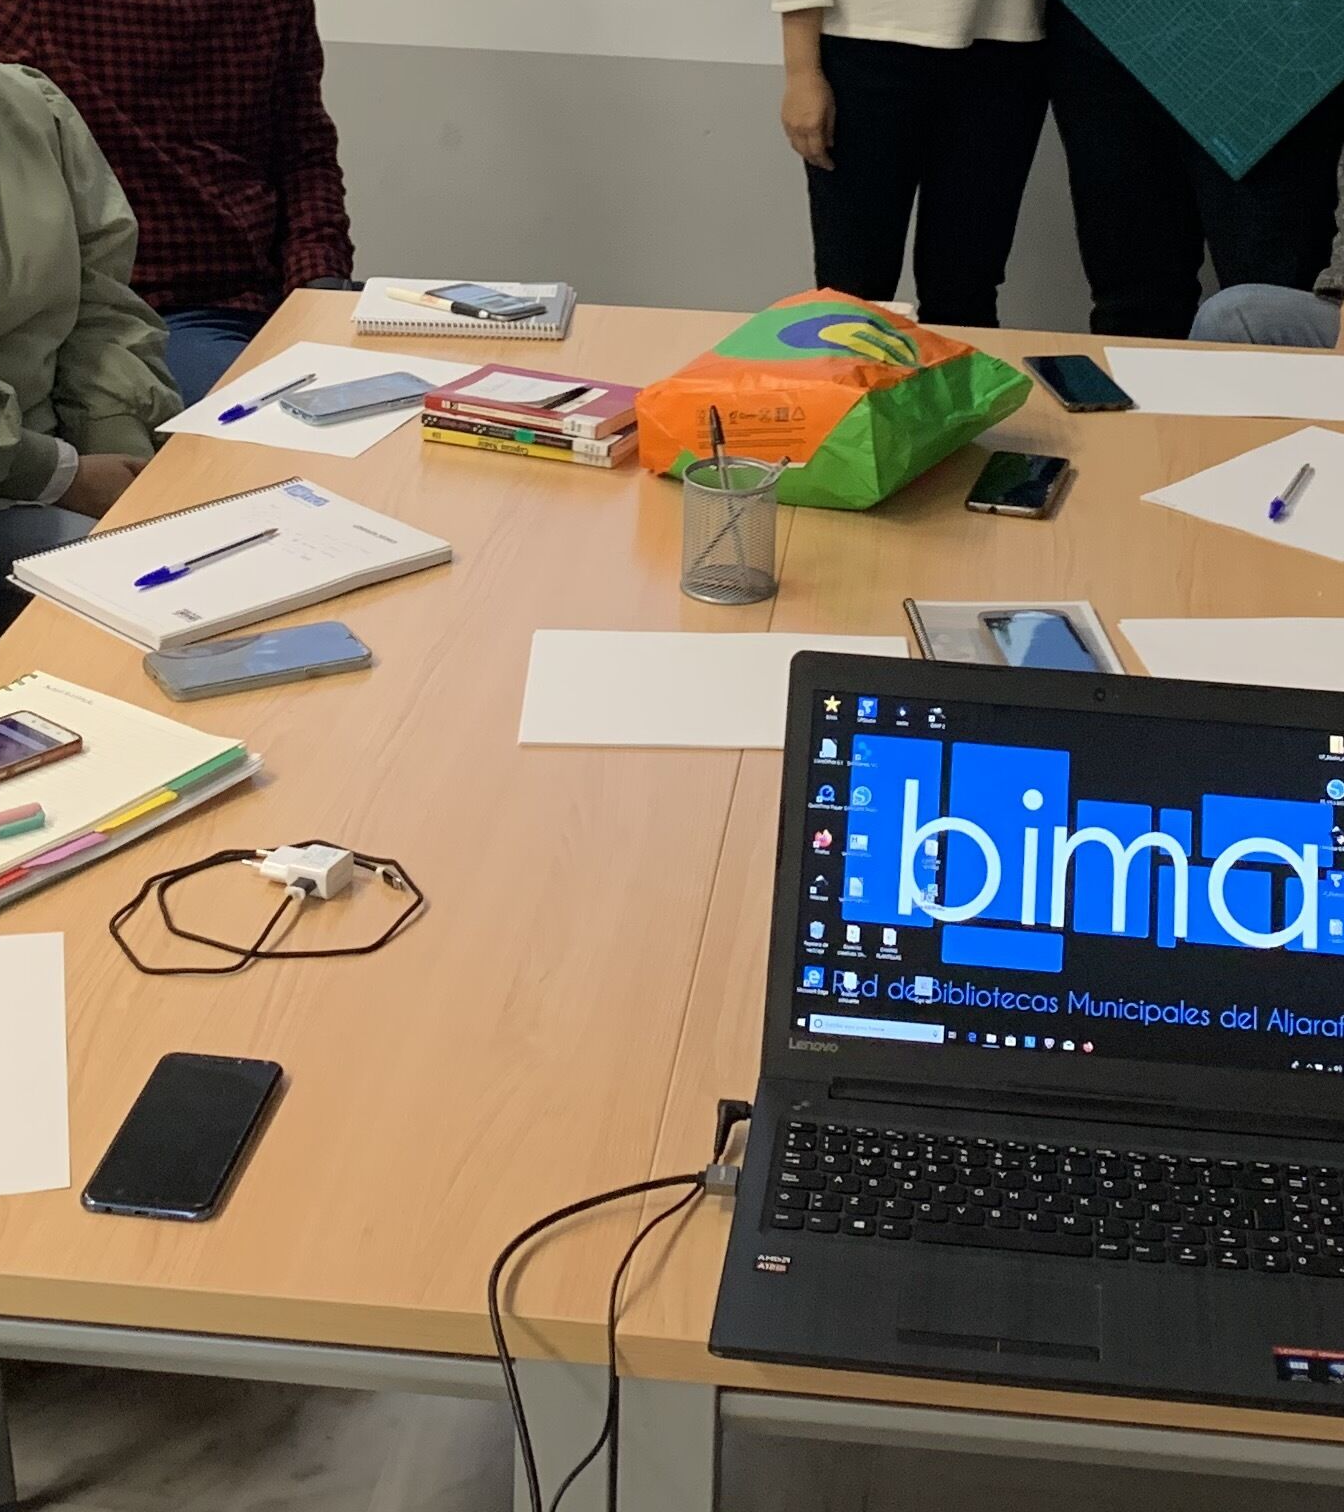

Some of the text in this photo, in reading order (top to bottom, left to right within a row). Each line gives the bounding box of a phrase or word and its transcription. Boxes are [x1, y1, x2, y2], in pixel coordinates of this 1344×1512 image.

[897, 779, 1320, 950] bima
[1067, 990, 1211, 1027] Municipales
[1220, 1004, 1258, 1031] del
[788, 1036, 840, 1054] Lenovo
